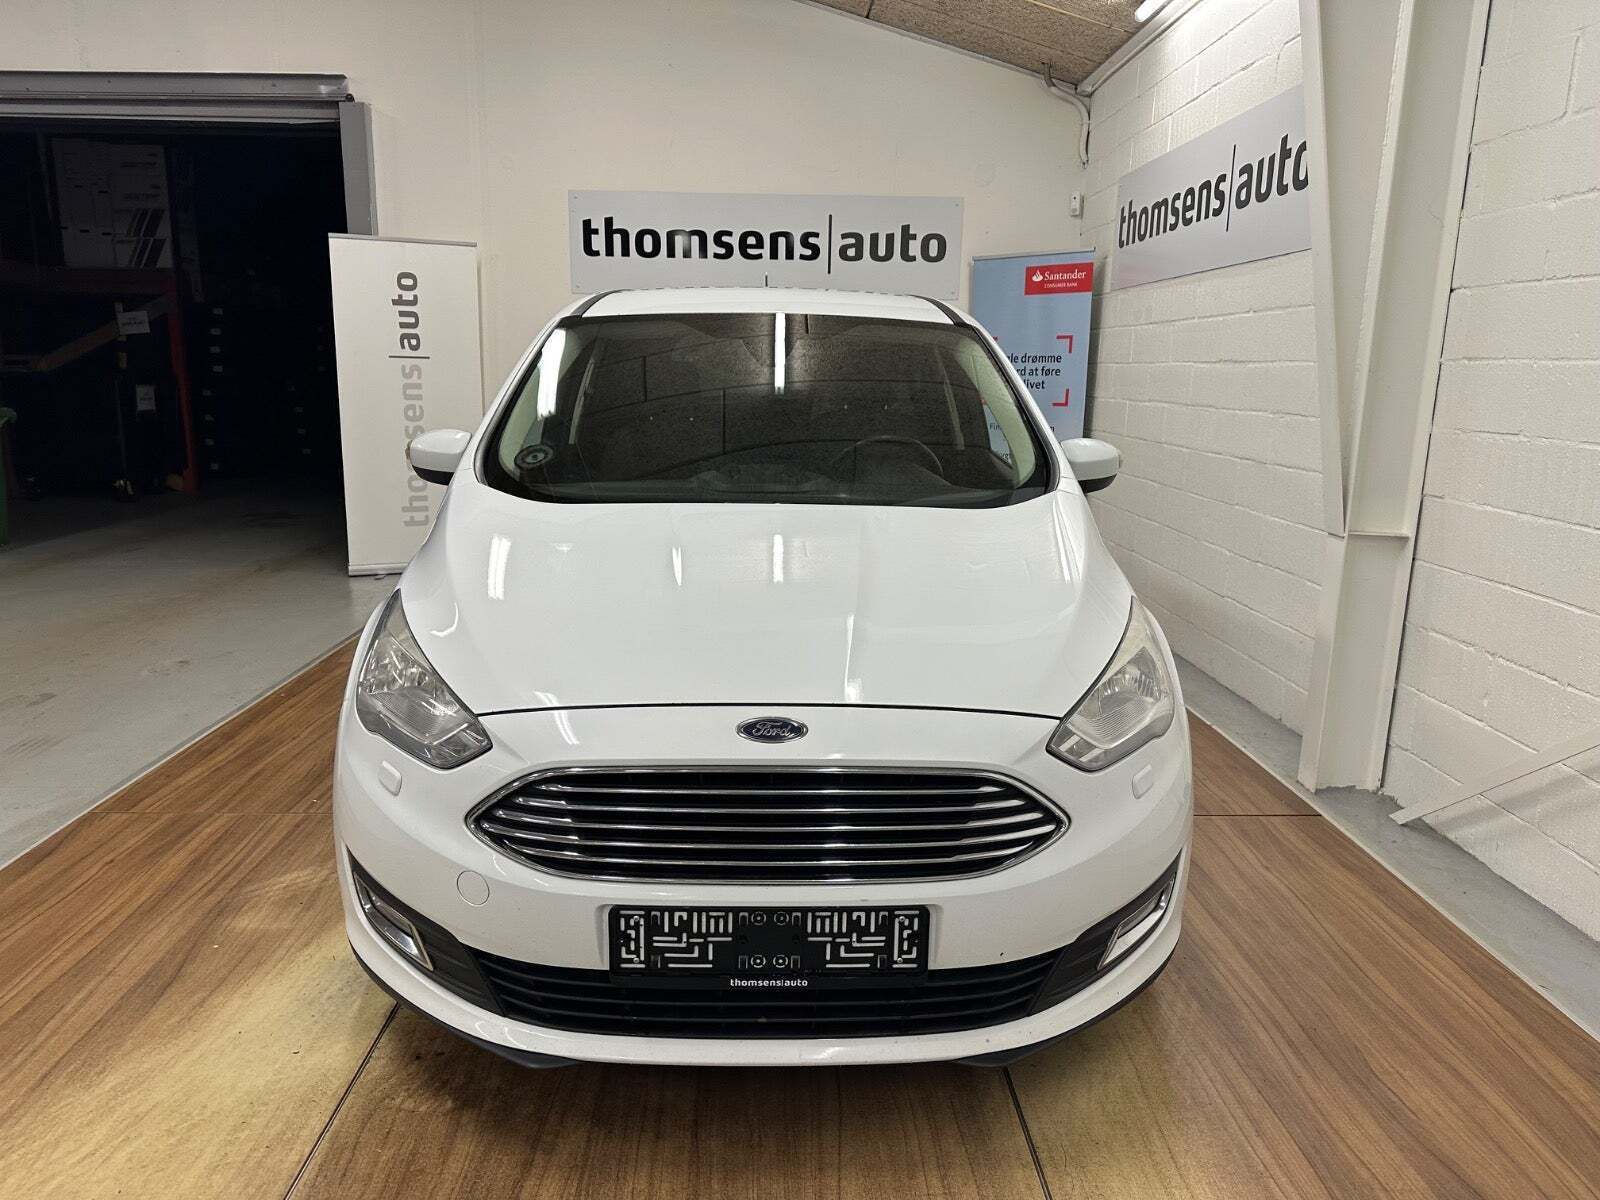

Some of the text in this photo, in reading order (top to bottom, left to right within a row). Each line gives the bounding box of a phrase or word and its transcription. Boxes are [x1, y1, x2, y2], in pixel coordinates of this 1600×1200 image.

[1044, 268, 1087, 281] Santander
[1021, 352, 1062, 363] drømme
[1016, 366, 1061, 377] rd at føre
[752, 721, 794, 737] Ford
